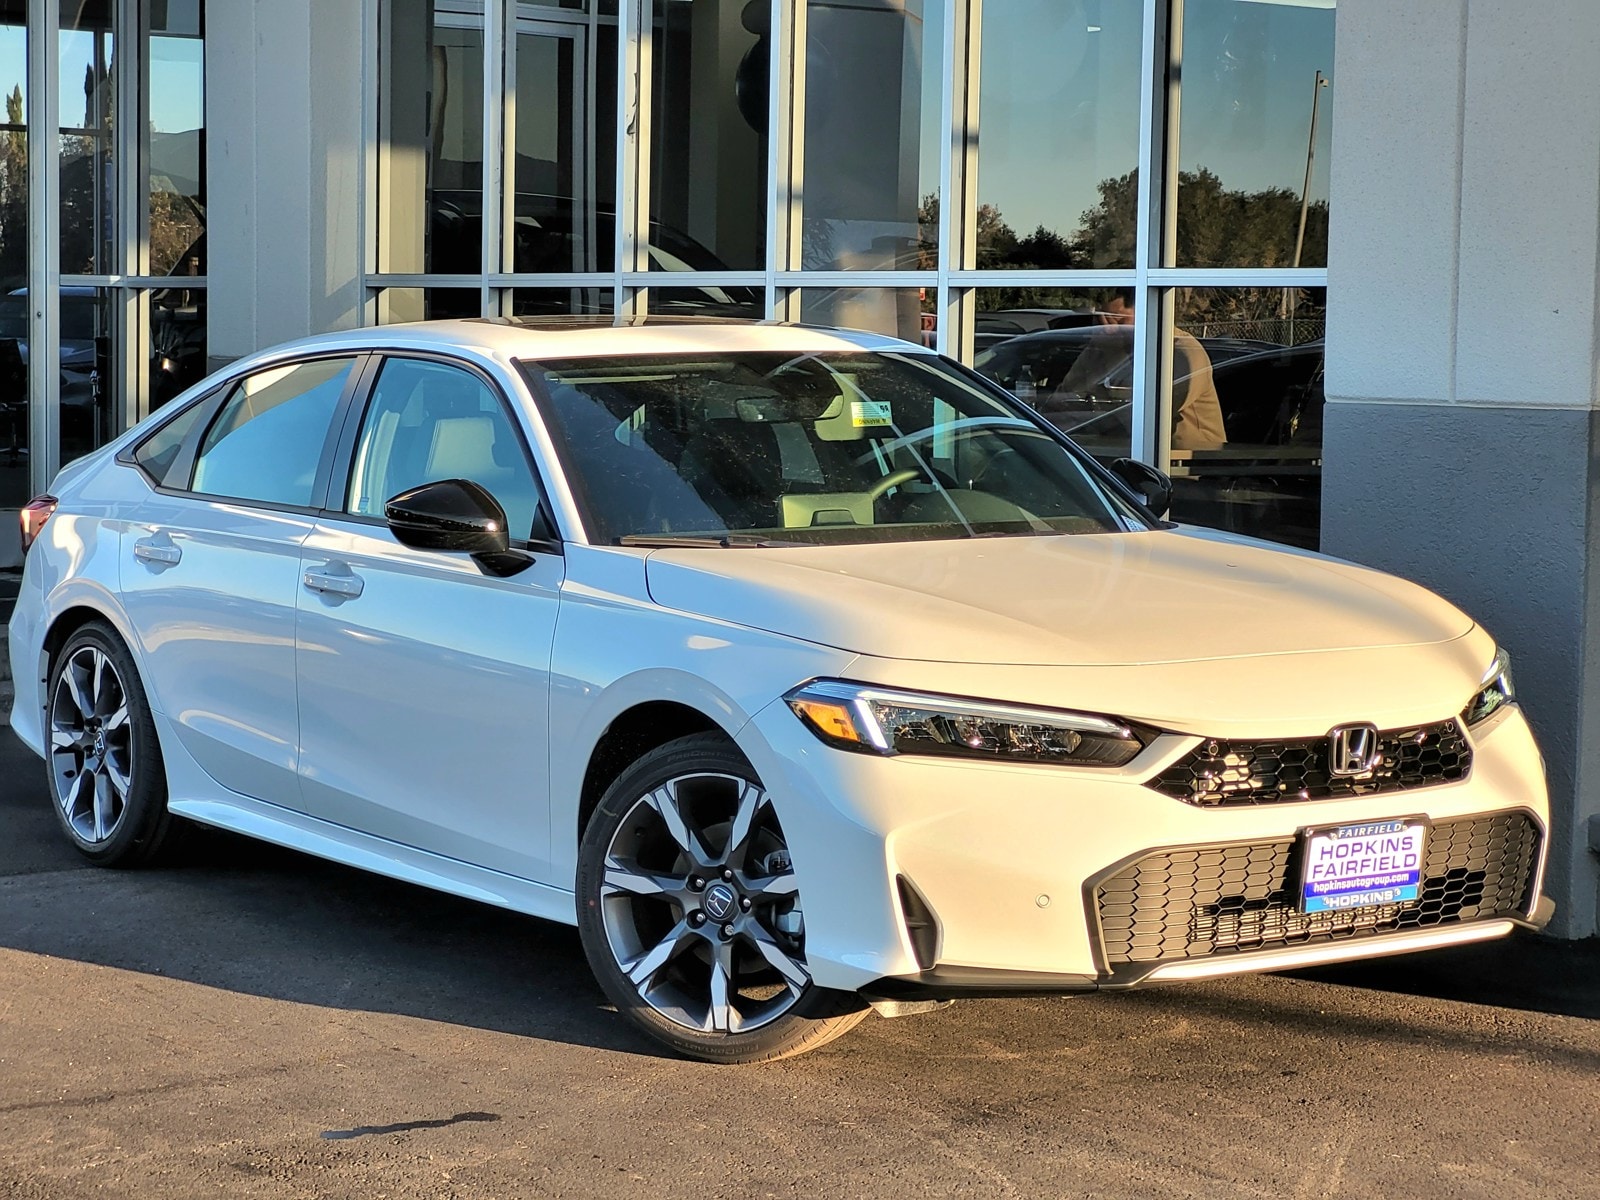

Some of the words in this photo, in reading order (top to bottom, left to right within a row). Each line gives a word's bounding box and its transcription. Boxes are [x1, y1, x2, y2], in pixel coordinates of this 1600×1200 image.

[1338, 823, 1402, 839] FAIRFIELD
[1320, 836, 1413, 860] HOPKINS
[1312, 853, 1417, 879] FAIRFIELD
[1313, 873, 1409, 893] hopkinsautogroup.com
[1329, 890, 1393, 908] HOPKINS
